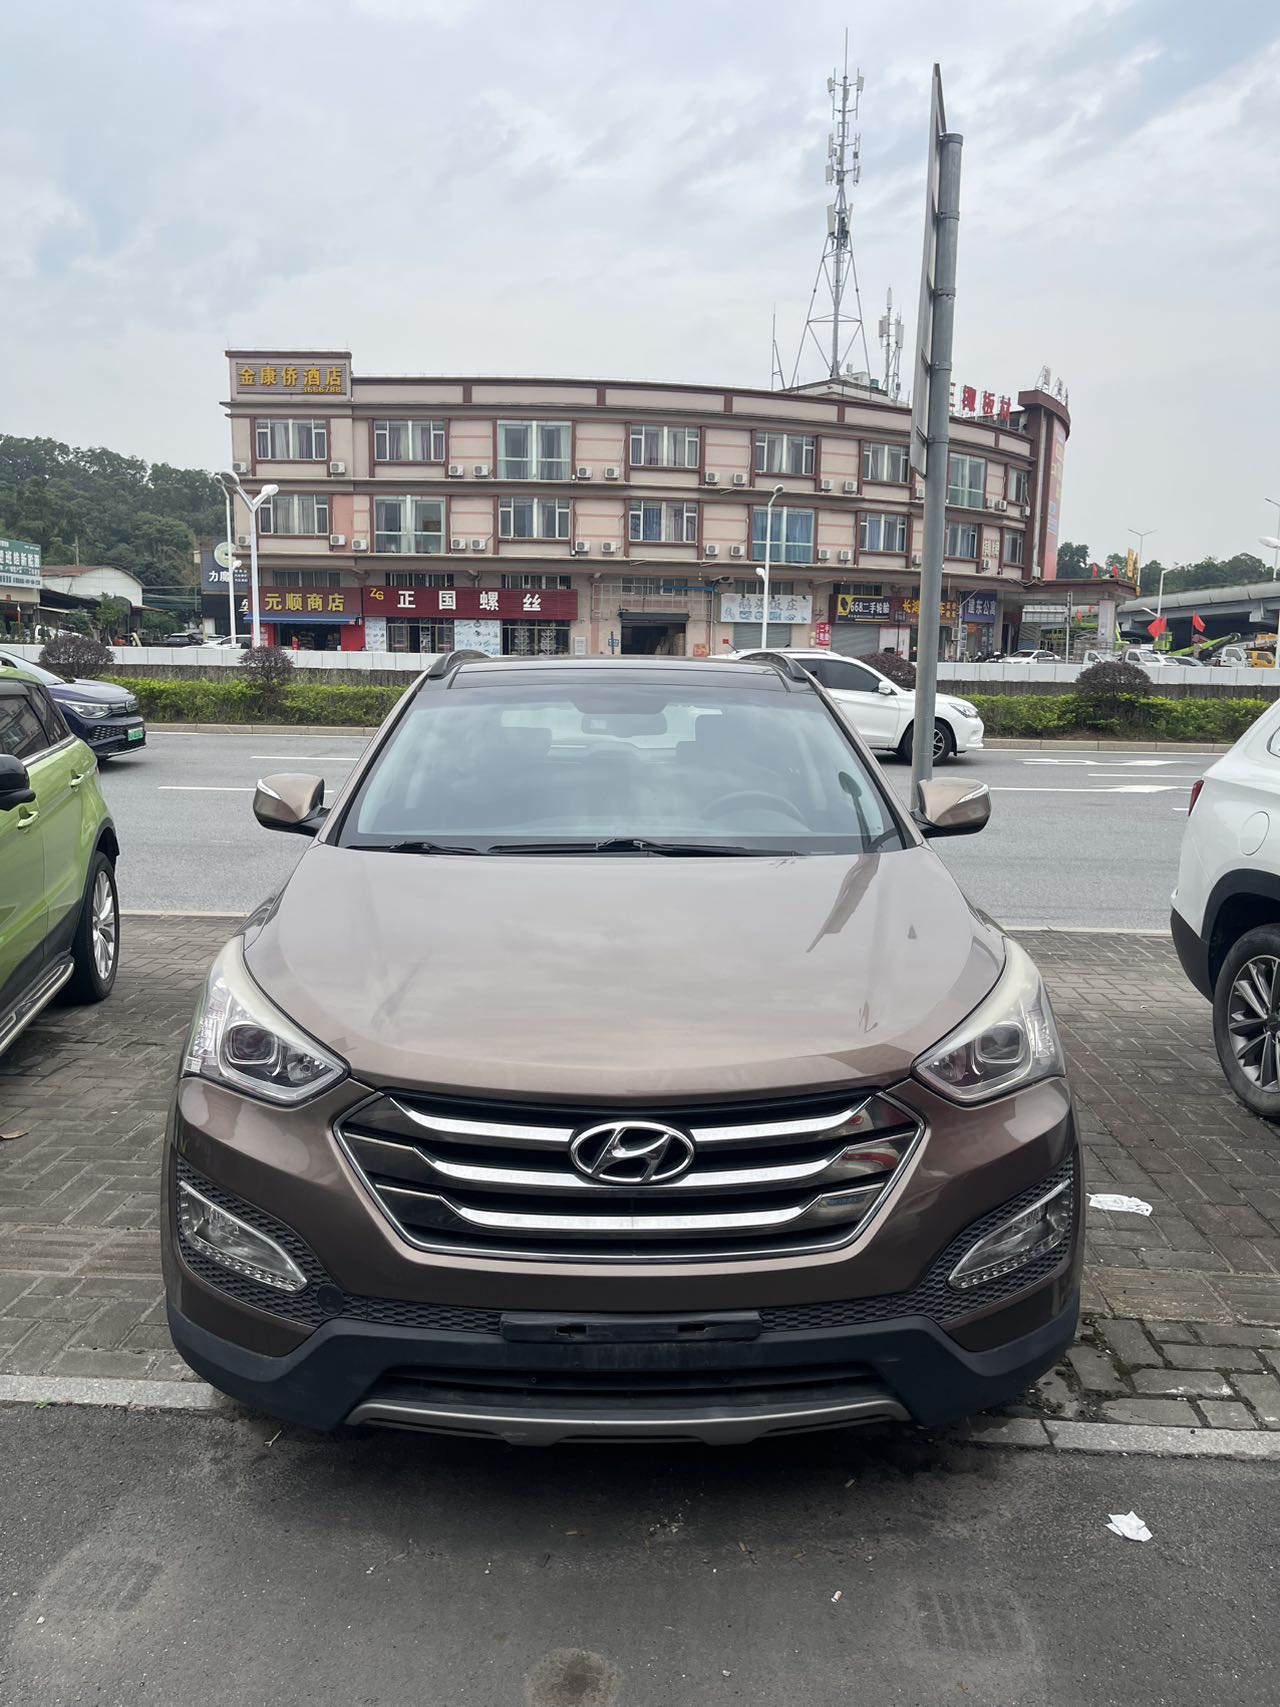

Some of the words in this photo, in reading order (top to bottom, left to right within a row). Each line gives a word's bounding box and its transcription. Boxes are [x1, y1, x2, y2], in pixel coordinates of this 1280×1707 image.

[240, 367, 342, 387] 金康侨酒店
[264, 593, 345, 612] 元顺商店
[397, 590, 542, 612] 正国螺丝
